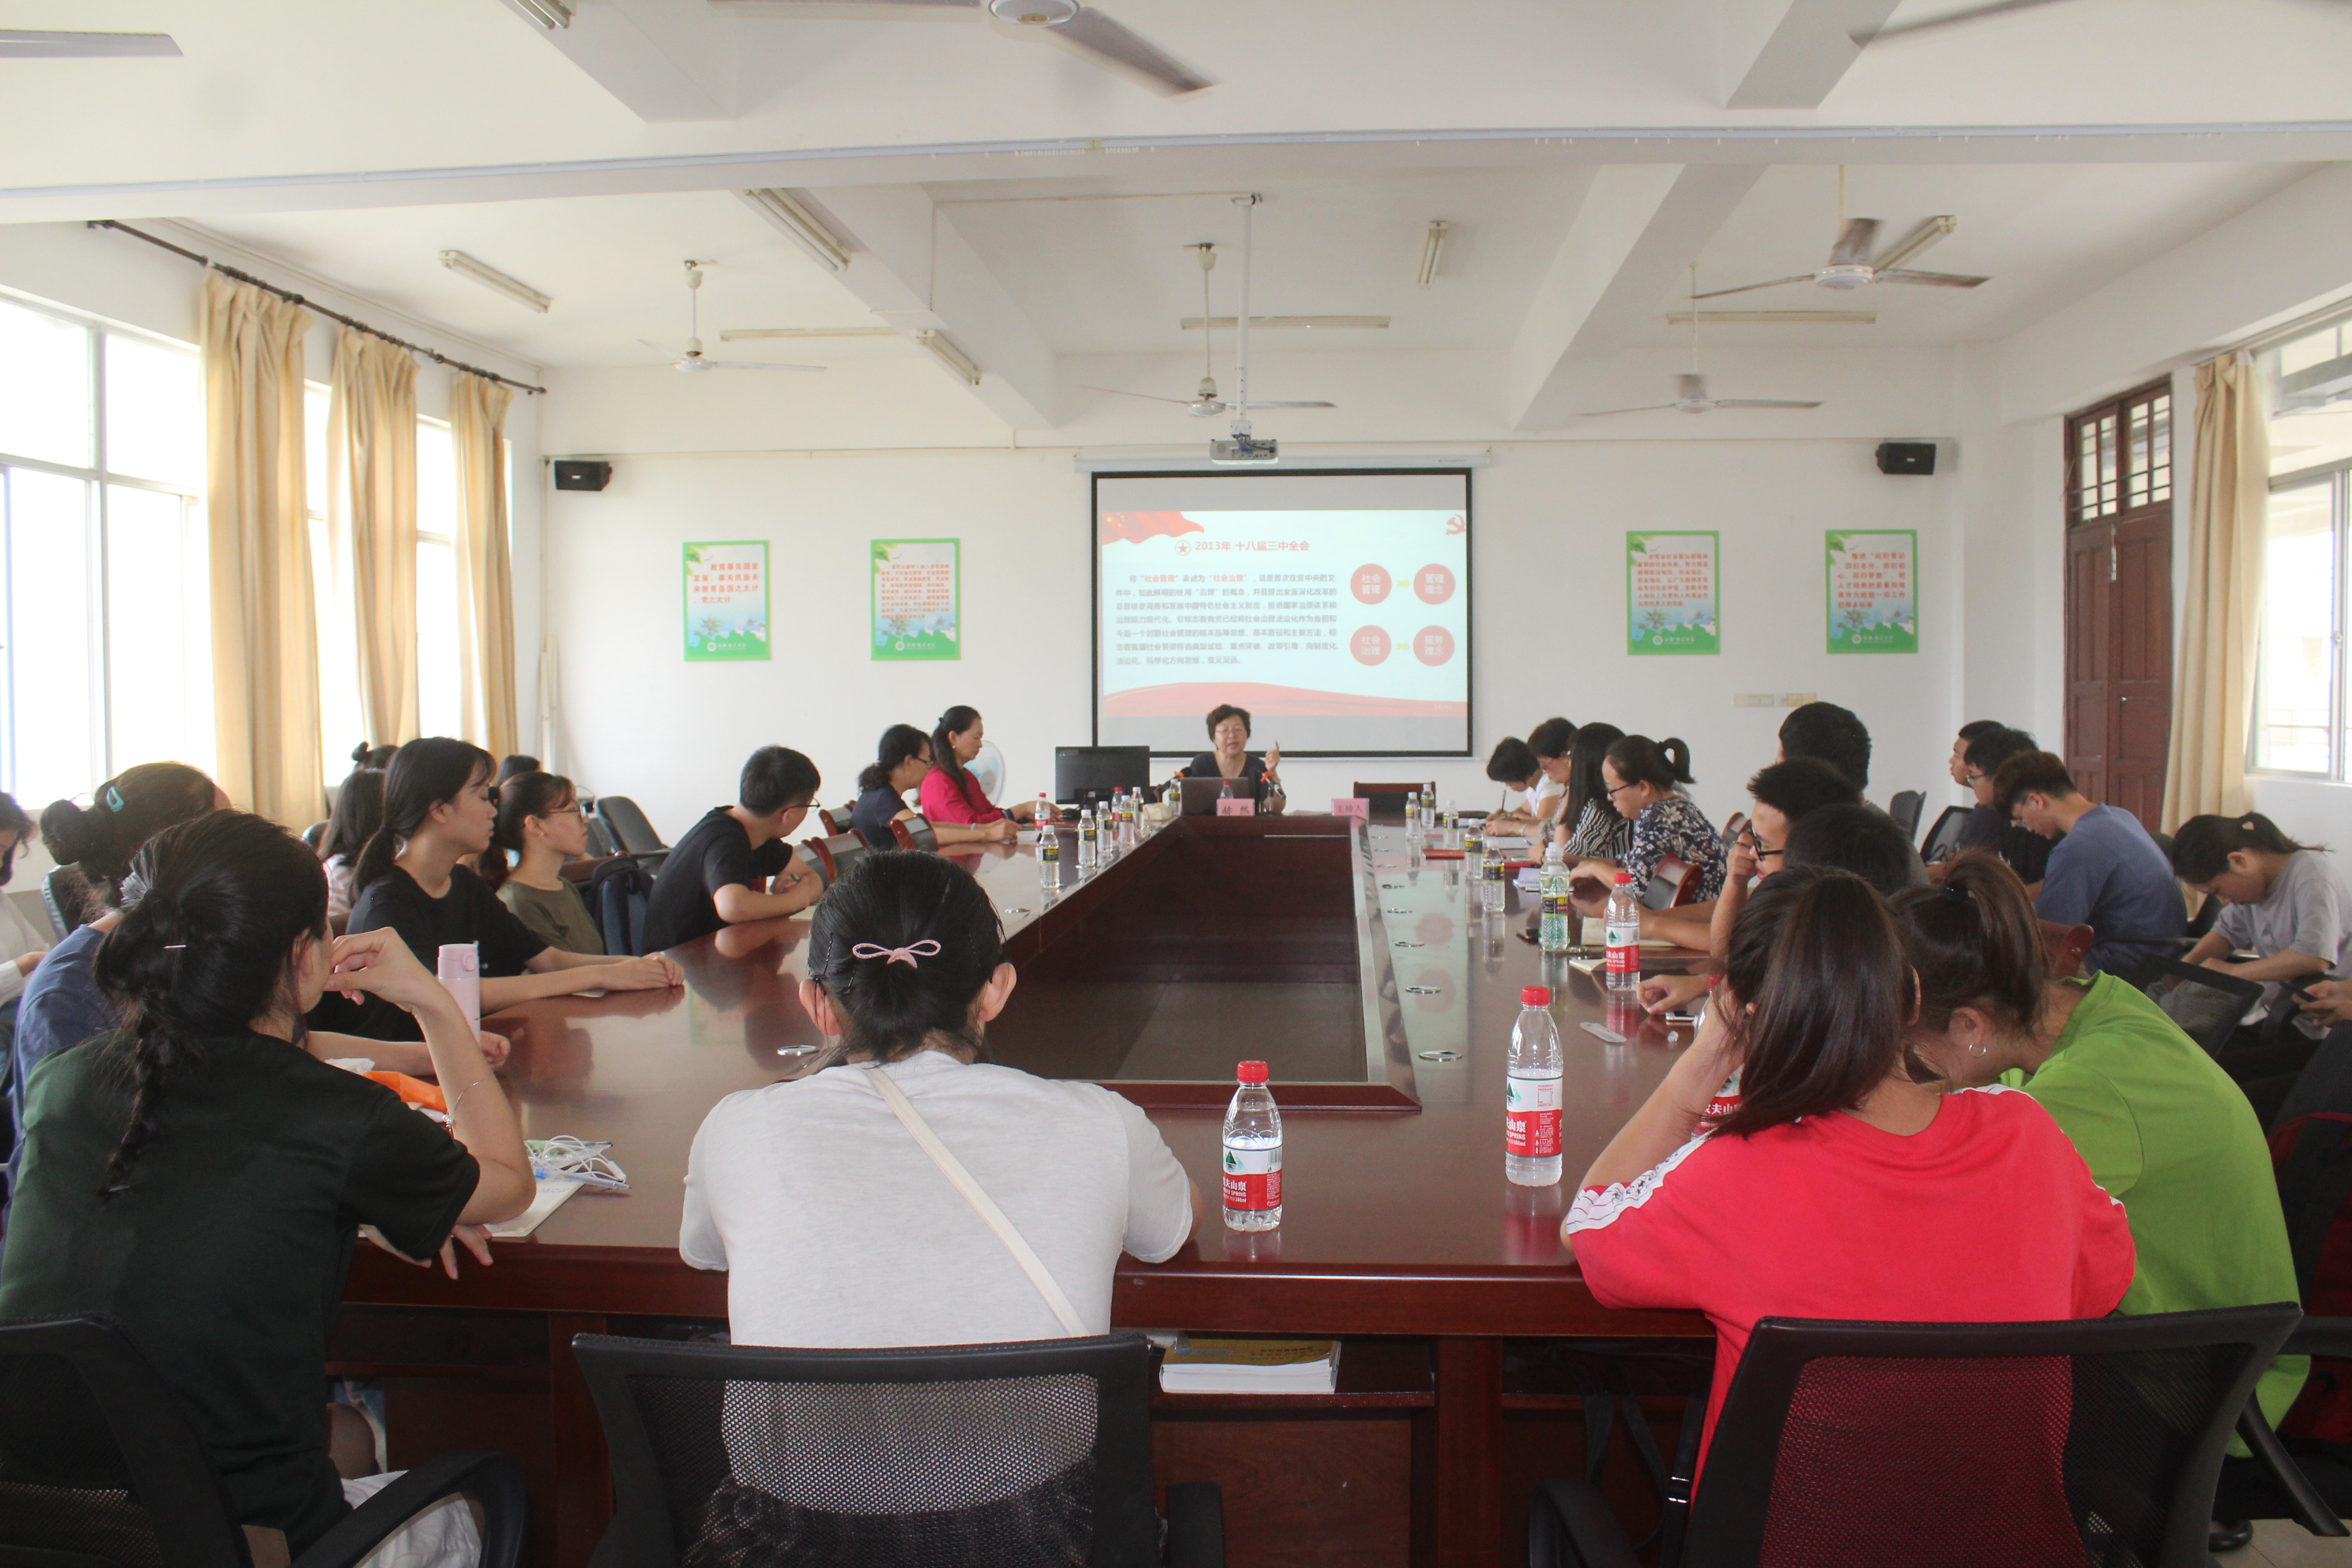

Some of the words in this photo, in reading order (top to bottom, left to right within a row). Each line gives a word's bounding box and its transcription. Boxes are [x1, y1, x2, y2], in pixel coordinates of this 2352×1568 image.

[1194, 541, 1232, 551] 2013年
[1235, 540, 1310, 551] 十八届三中全会
[1362, 574, 1381, 583] 社会
[1425, 574, 1444, 583] 管理
[1362, 585, 1381, 594] 管理
[1425, 585, 1444, 594] 理念
[1362, 635, 1380, 644] 社会
[1362, 646, 1380, 655] 治理
[1424, 647, 1443, 656] 理念
[1336, 805, 1363, 813] 主持人
[1509, 1131, 1526, 1140] SPRING
